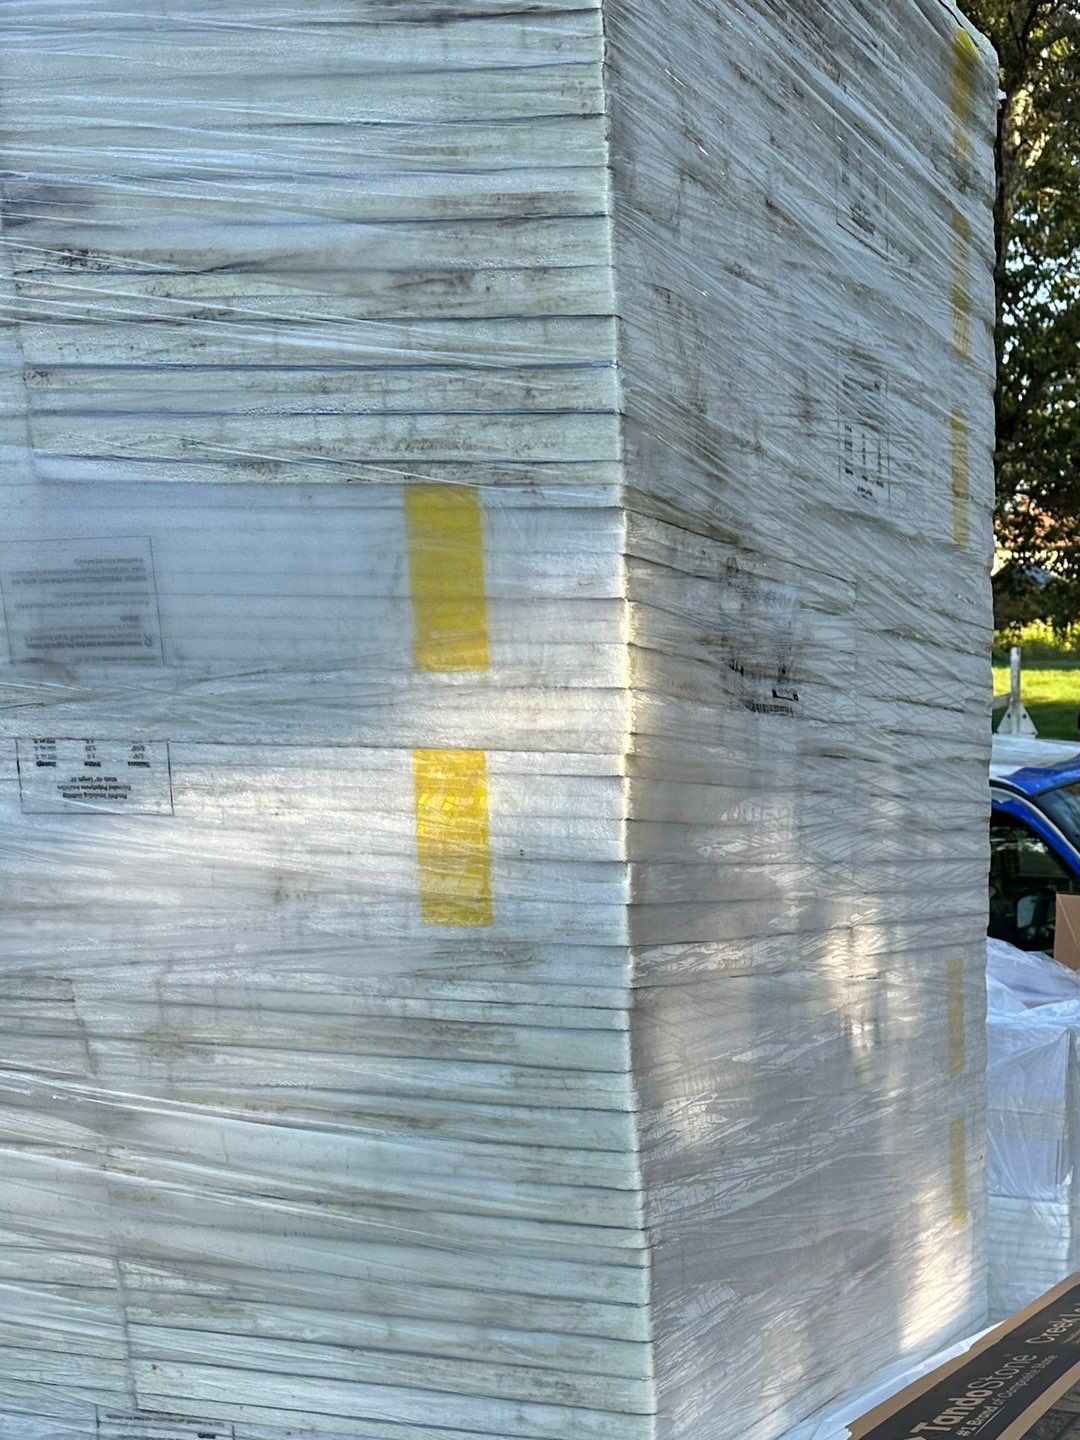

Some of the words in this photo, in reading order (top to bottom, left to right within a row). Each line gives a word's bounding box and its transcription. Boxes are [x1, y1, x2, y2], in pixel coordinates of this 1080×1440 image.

[1025, 1316, 1074, 1345] Creek
[910, 1353, 1038, 1436] TandoStone
[969, 1402, 1000, 1429] Brand
